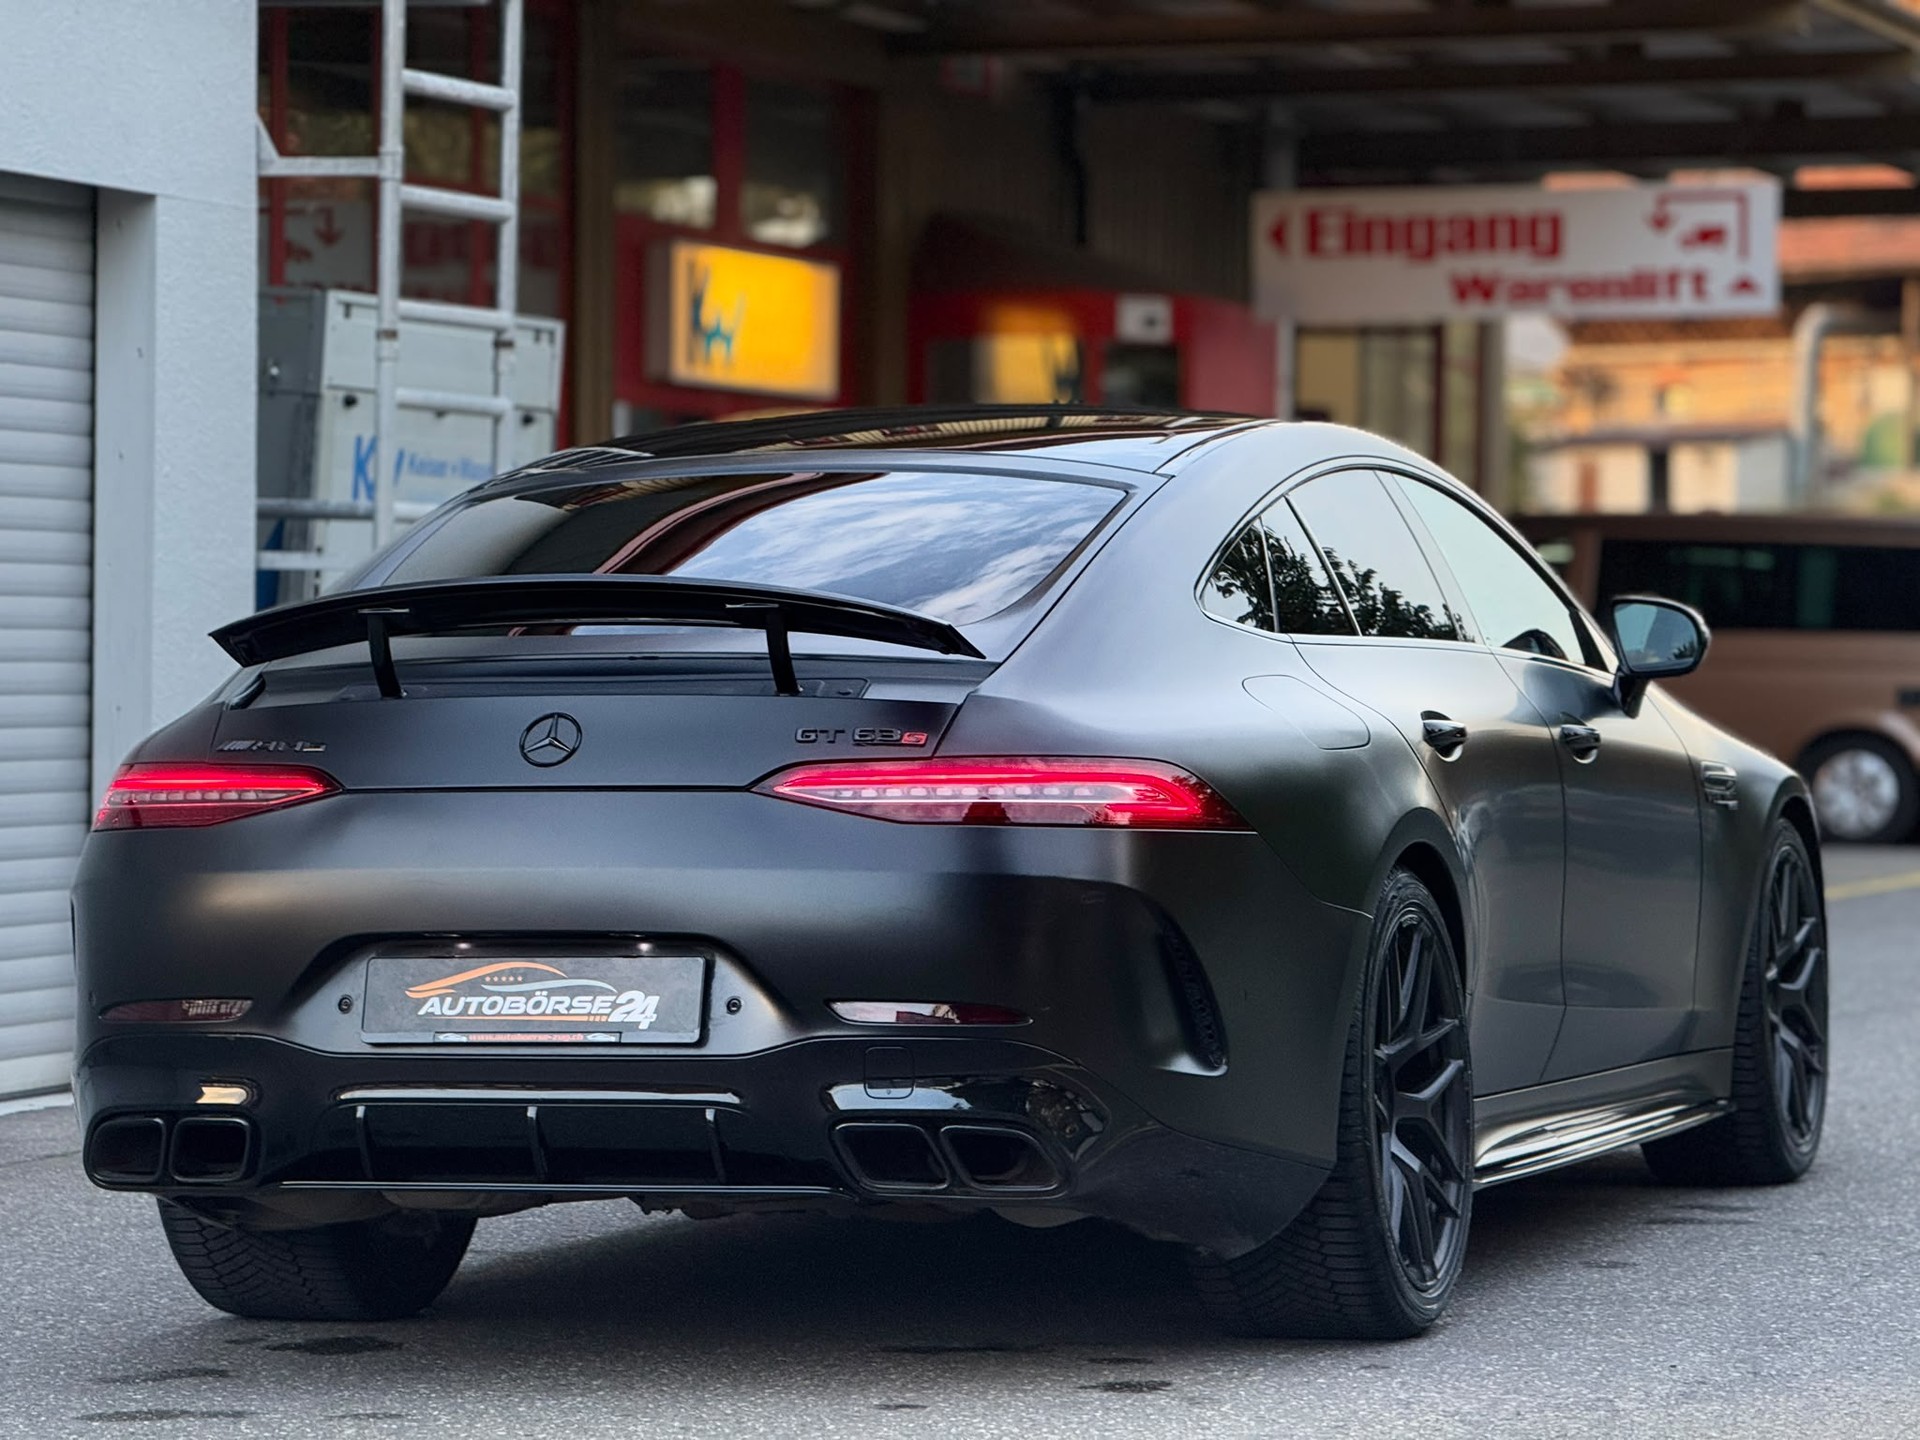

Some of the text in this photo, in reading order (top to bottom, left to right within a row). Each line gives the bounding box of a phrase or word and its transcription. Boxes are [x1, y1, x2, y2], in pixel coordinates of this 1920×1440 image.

[1306, 206, 1564, 262] Eingang
[1451, 268, 1709, 304] Warenlift
[795, 727, 845, 744] GT
